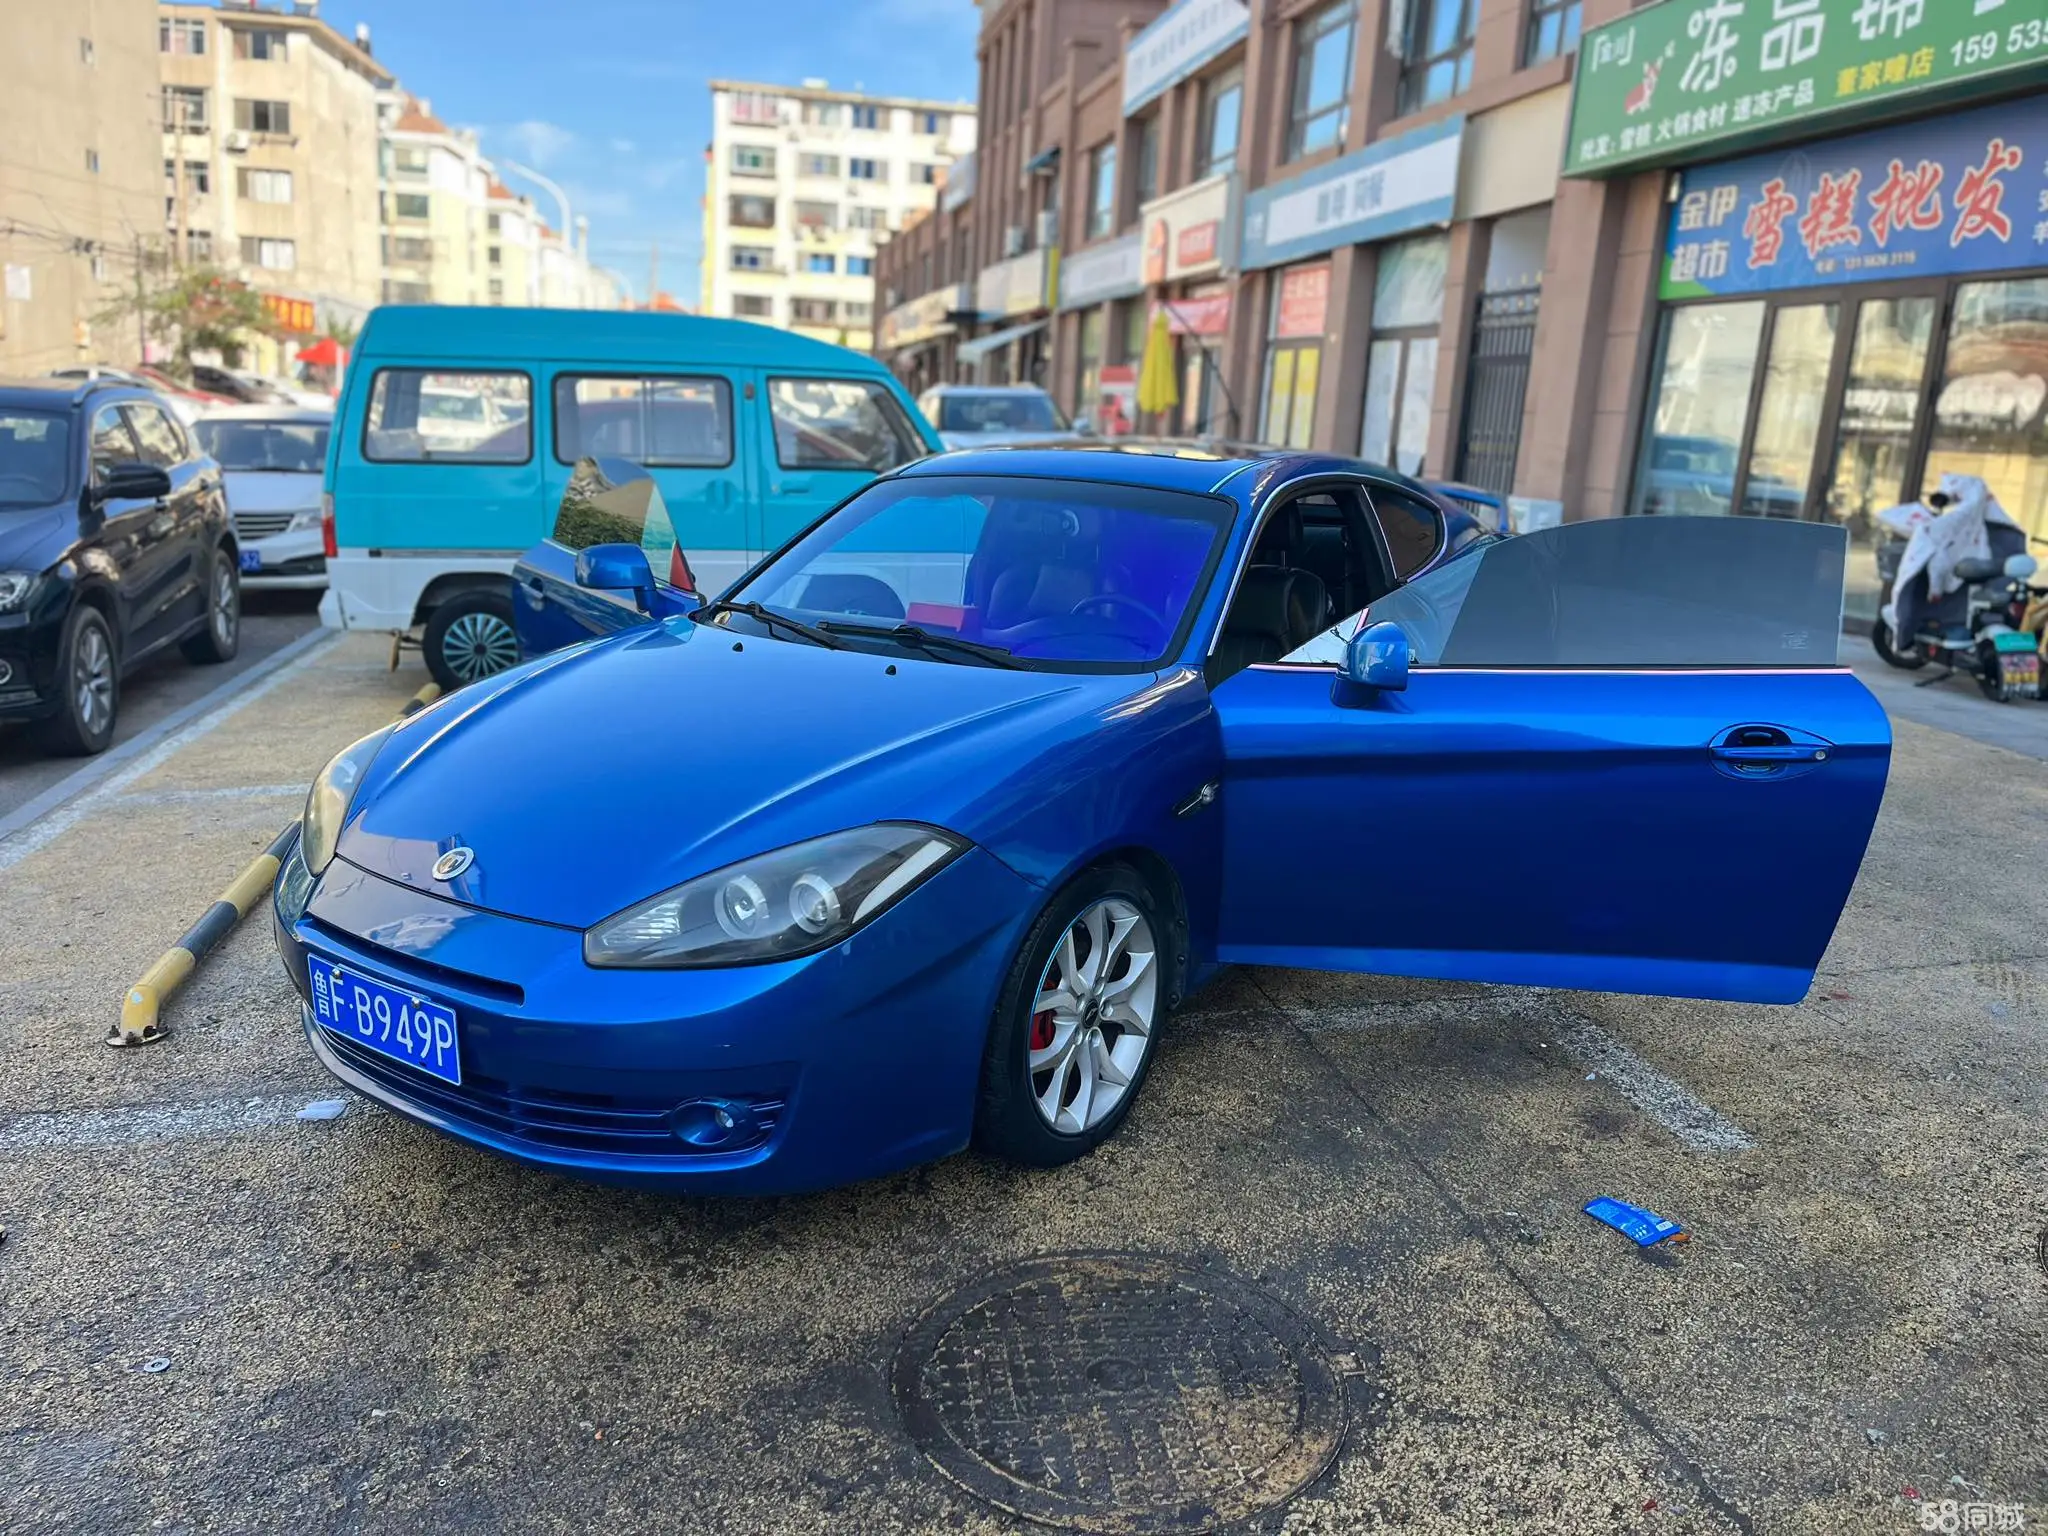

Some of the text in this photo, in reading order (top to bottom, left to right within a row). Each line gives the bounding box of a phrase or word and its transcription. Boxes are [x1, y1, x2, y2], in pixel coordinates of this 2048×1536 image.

[1950, 31, 1999, 67] 159
[1656, 102, 1728, 142] 火锅食材
[1732, 78, 1814, 122] 速冻产品
[1677, 185, 1738, 232] 金伊
[1743, 138, 2022, 269] 雪糕批发
[1670, 240, 1730, 283] 超市
